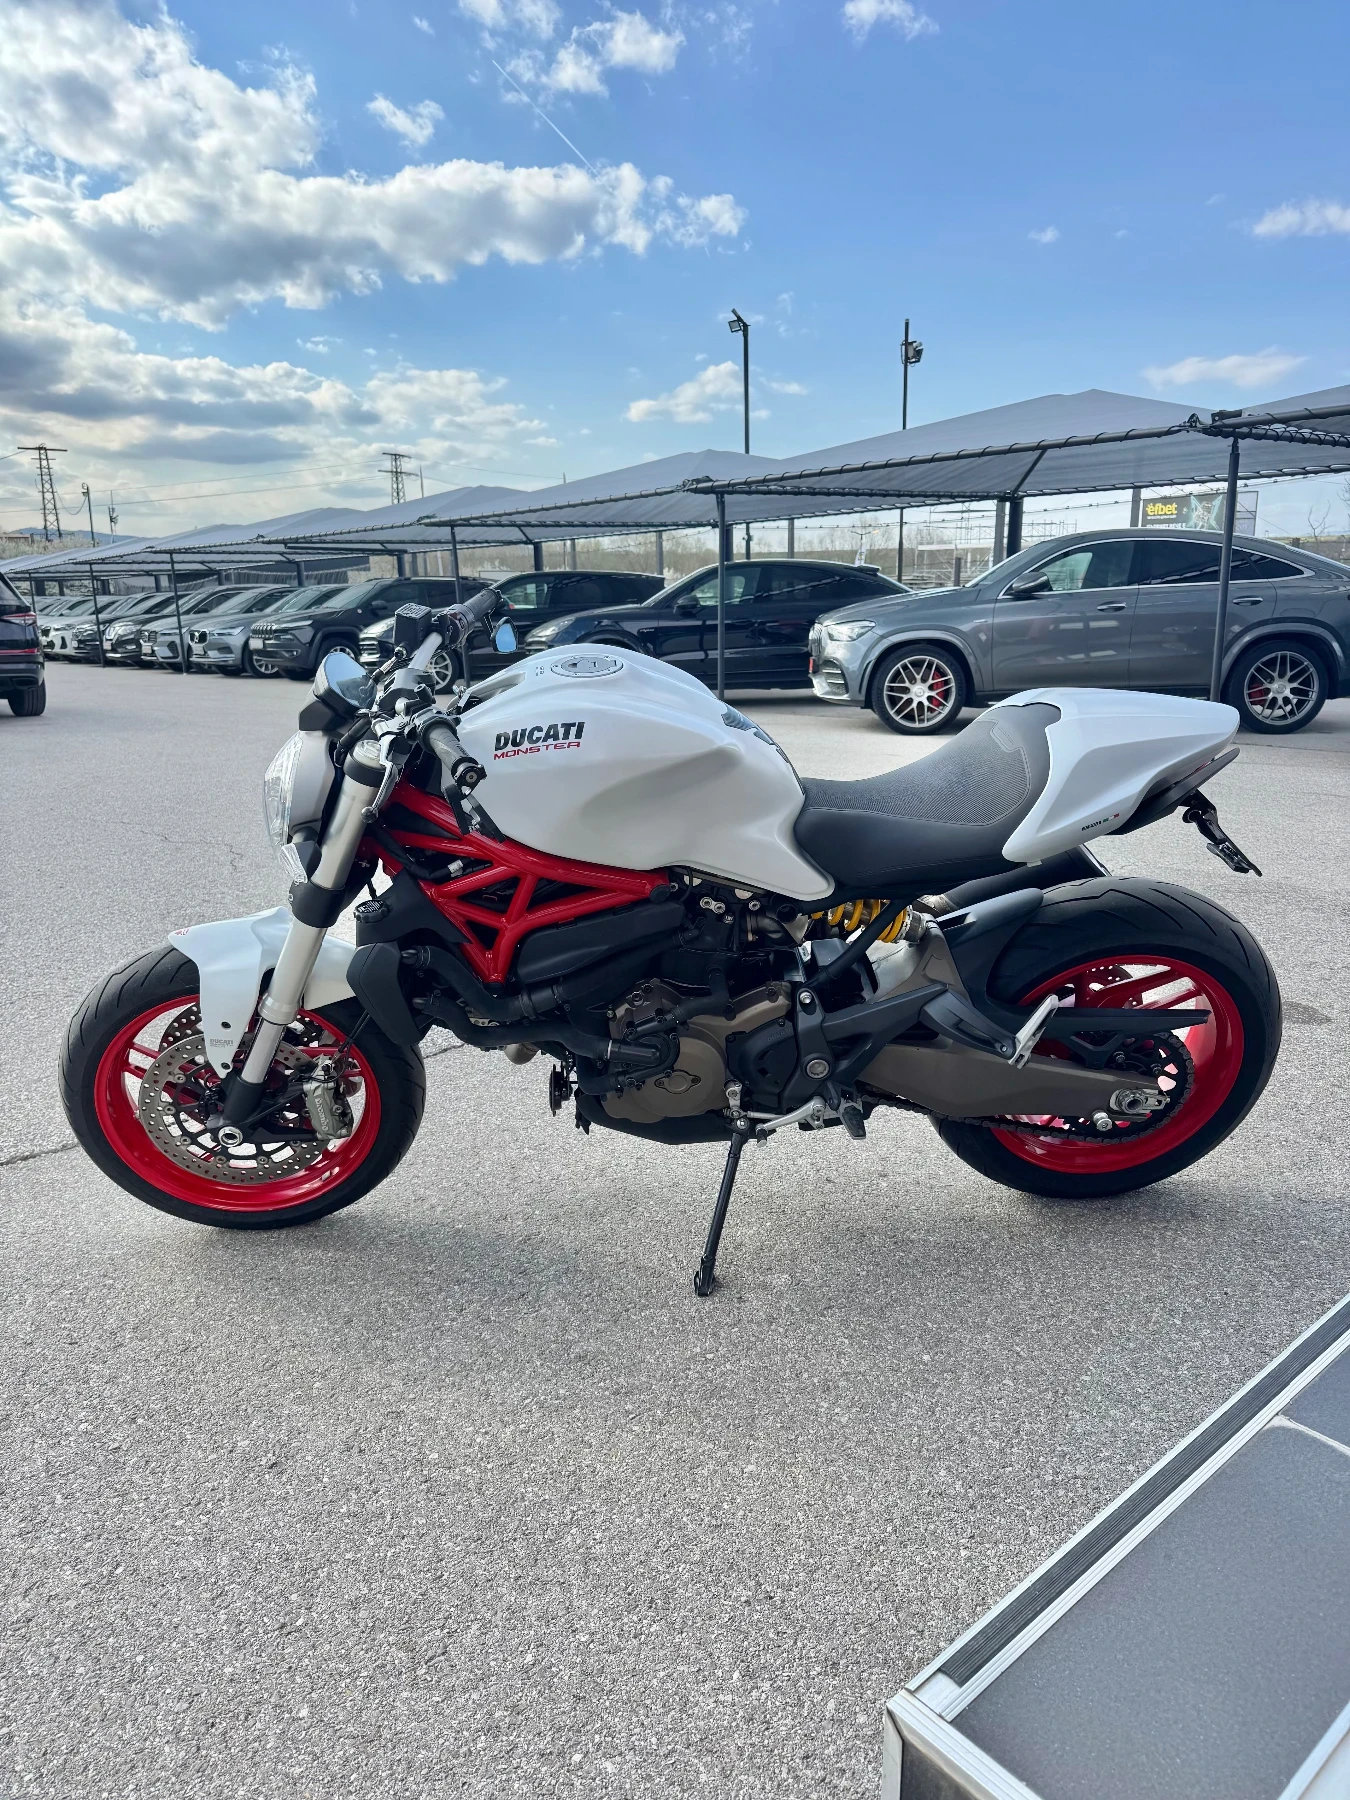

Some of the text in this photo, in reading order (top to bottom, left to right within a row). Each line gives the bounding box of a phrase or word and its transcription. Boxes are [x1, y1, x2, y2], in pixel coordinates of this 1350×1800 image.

[1146, 502, 1177, 515] efbet
[494, 721, 585, 751] DUCATI
[493, 741, 581, 760] MONSTER
